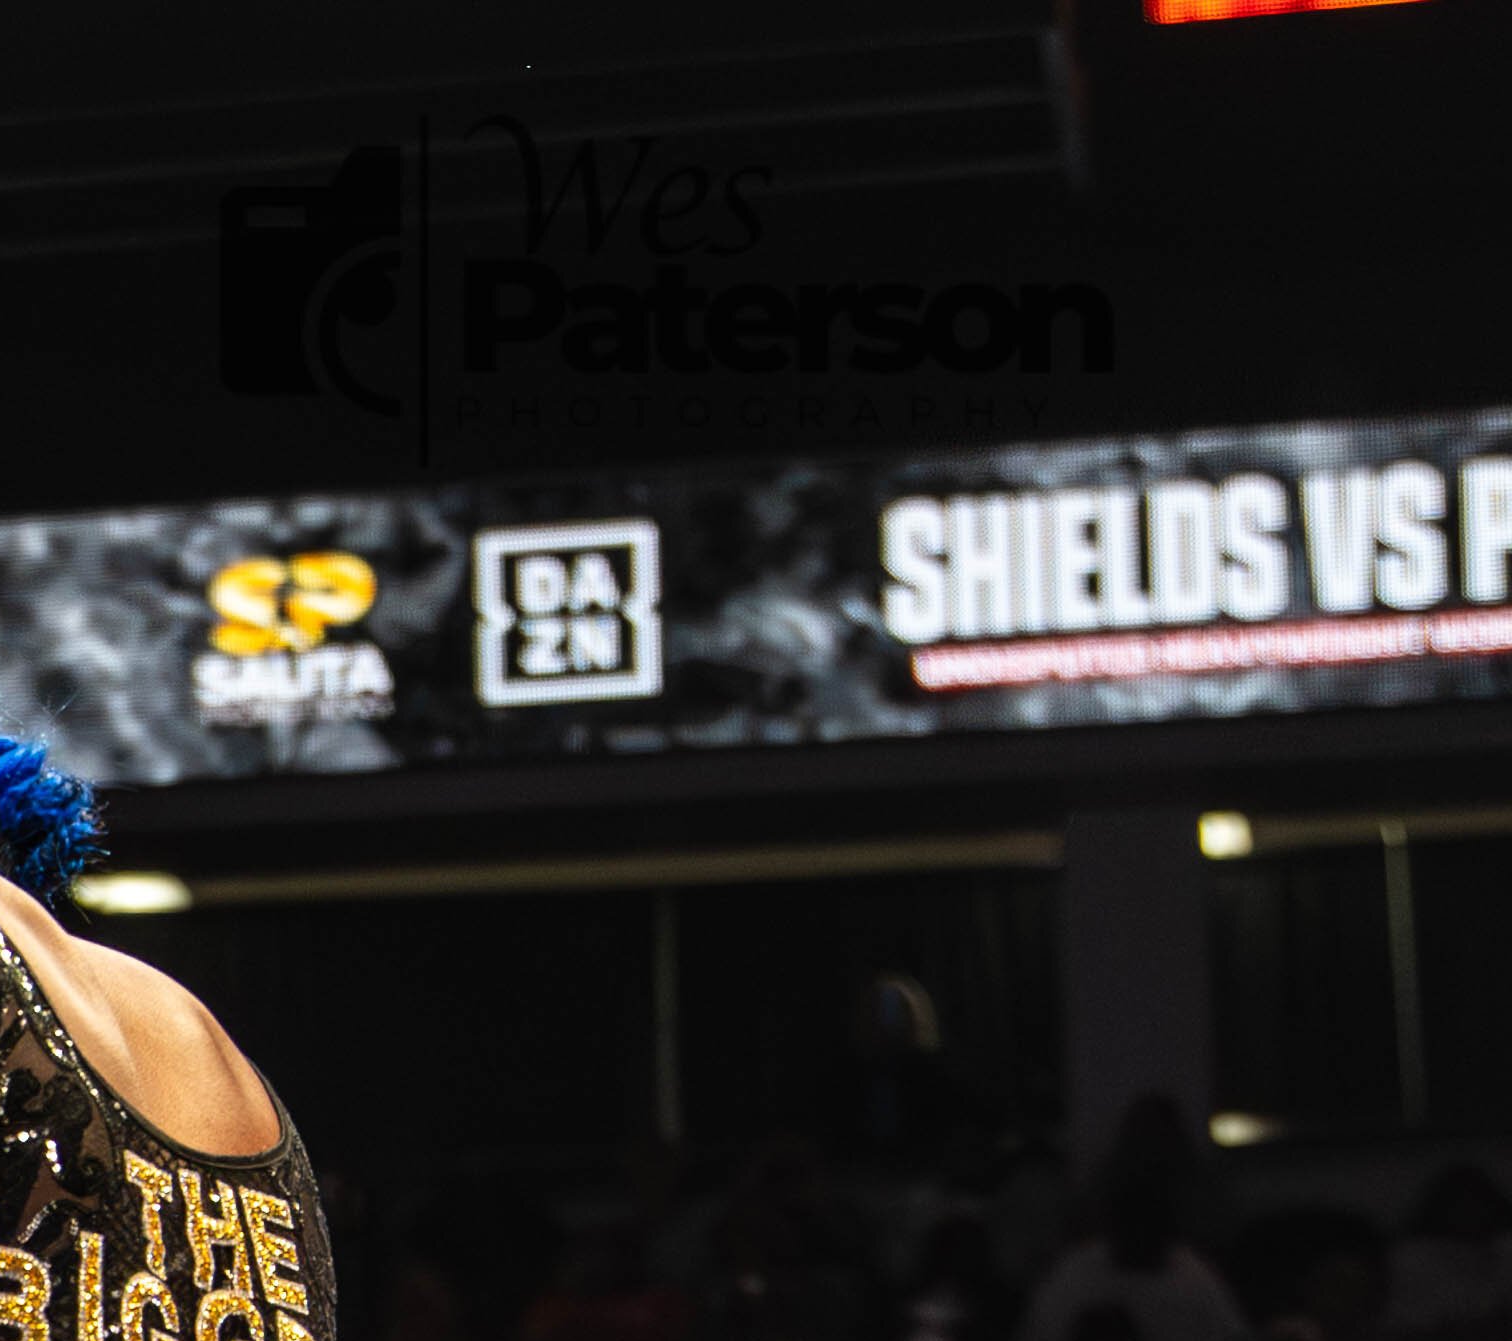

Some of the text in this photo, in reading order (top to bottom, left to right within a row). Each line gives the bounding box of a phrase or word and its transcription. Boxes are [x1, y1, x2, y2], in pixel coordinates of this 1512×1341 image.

[880, 475, 1292, 643] SHIELDS
[1298, 459, 1448, 613] VS
[122, 1148, 311, 1316] THE
